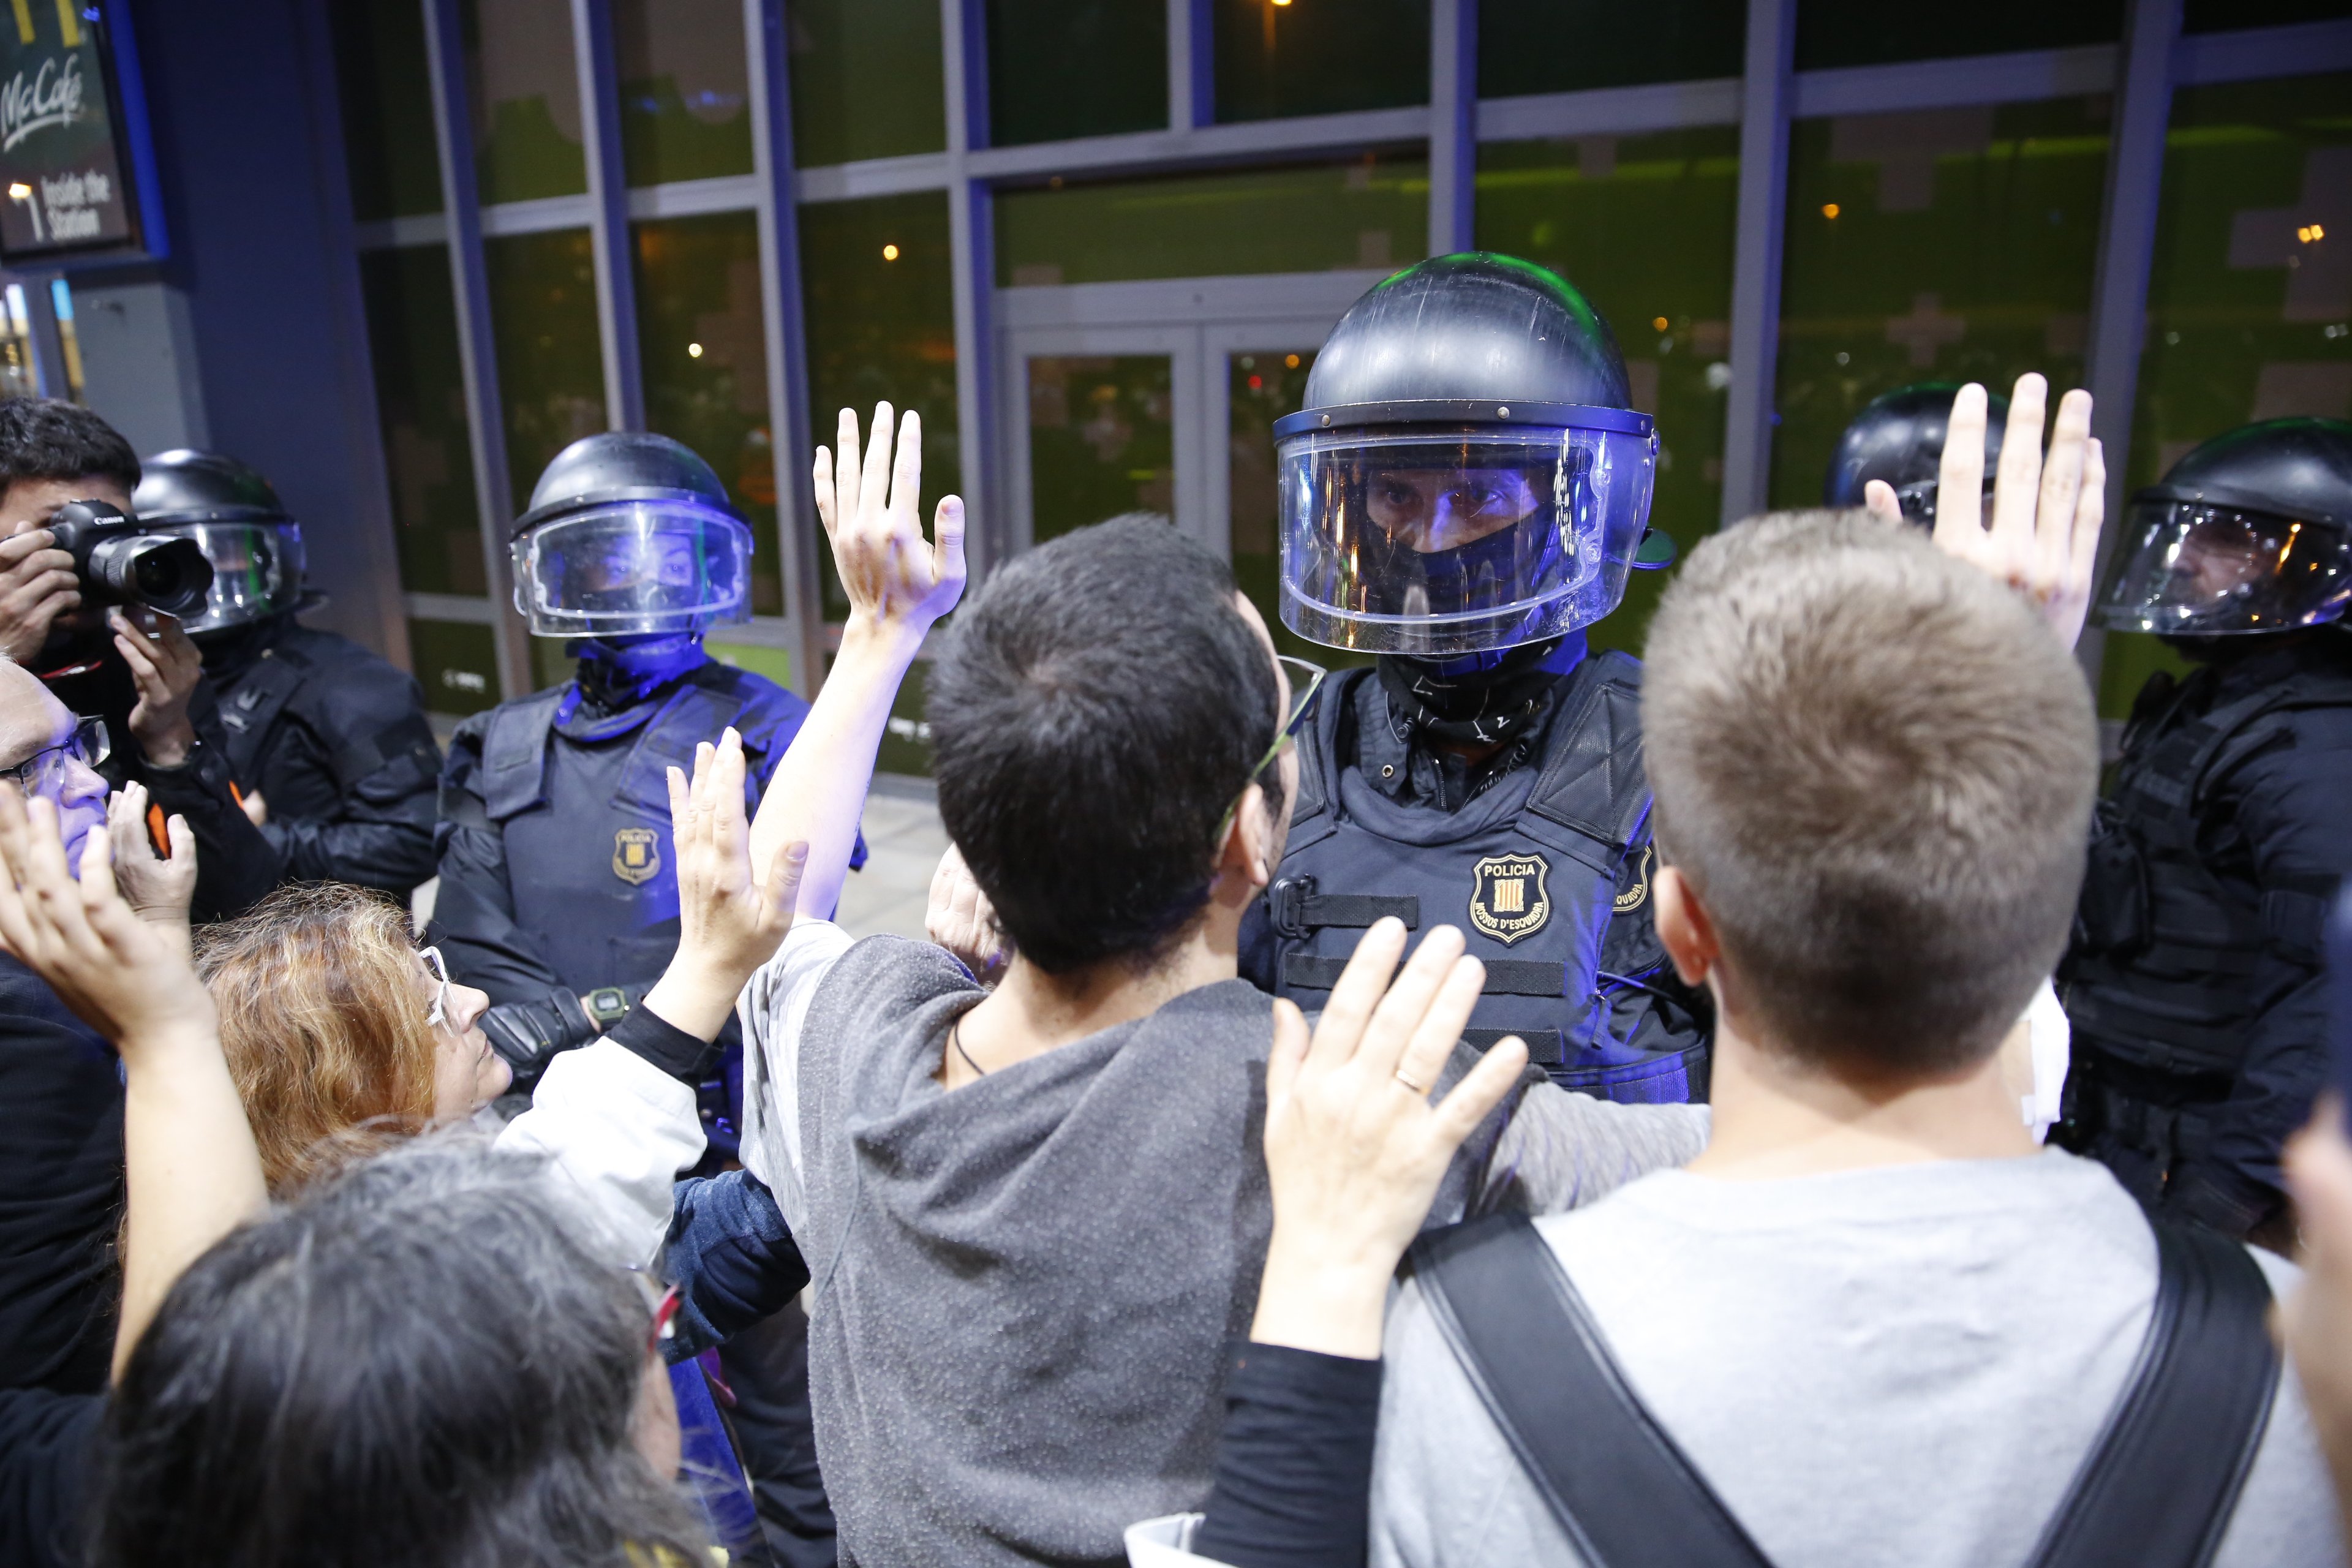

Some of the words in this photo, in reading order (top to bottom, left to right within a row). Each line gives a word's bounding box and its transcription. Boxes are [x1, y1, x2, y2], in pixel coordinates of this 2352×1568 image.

[94, 516, 125, 526] Canon
[1484, 864, 1536, 877] POLICIA
[1615, 884, 1644, 905] QUADRA
[1475, 902, 1499, 929] MOSSOS
[1499, 902, 1544, 930] D'ESQUADRA
